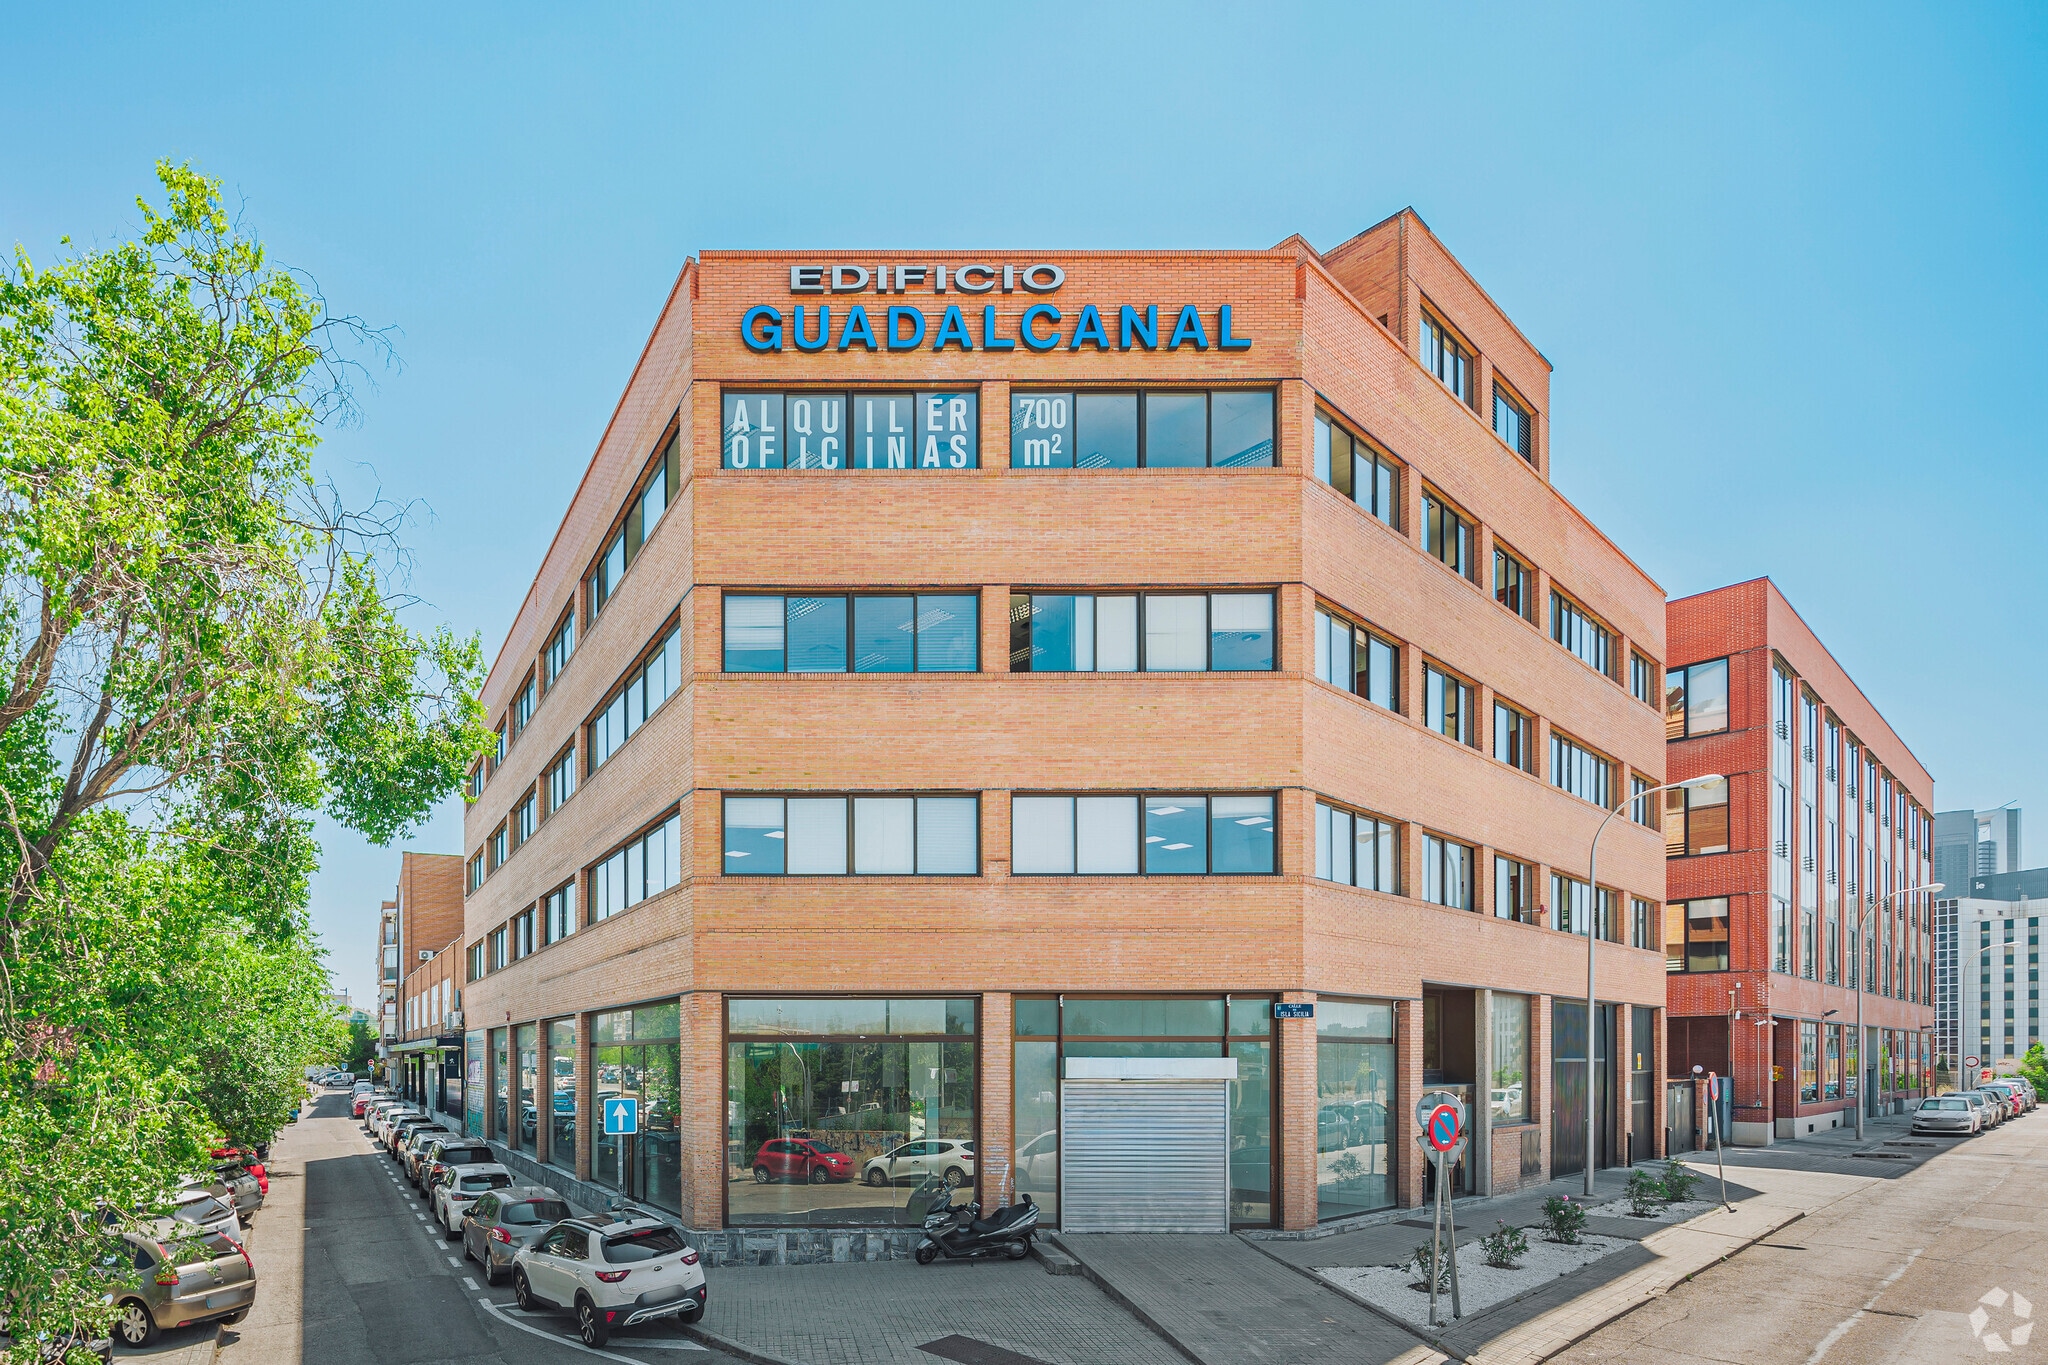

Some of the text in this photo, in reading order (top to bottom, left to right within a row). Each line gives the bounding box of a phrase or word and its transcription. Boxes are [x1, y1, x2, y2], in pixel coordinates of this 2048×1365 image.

[790, 265, 1066, 294] EDIFICIO
[740, 304, 1252, 353] GUADALCANAL
[732, 399, 968, 436] ALQUILER
[1019, 399, 1067, 429] 700
[731, 434, 968, 469] OFICINAS
